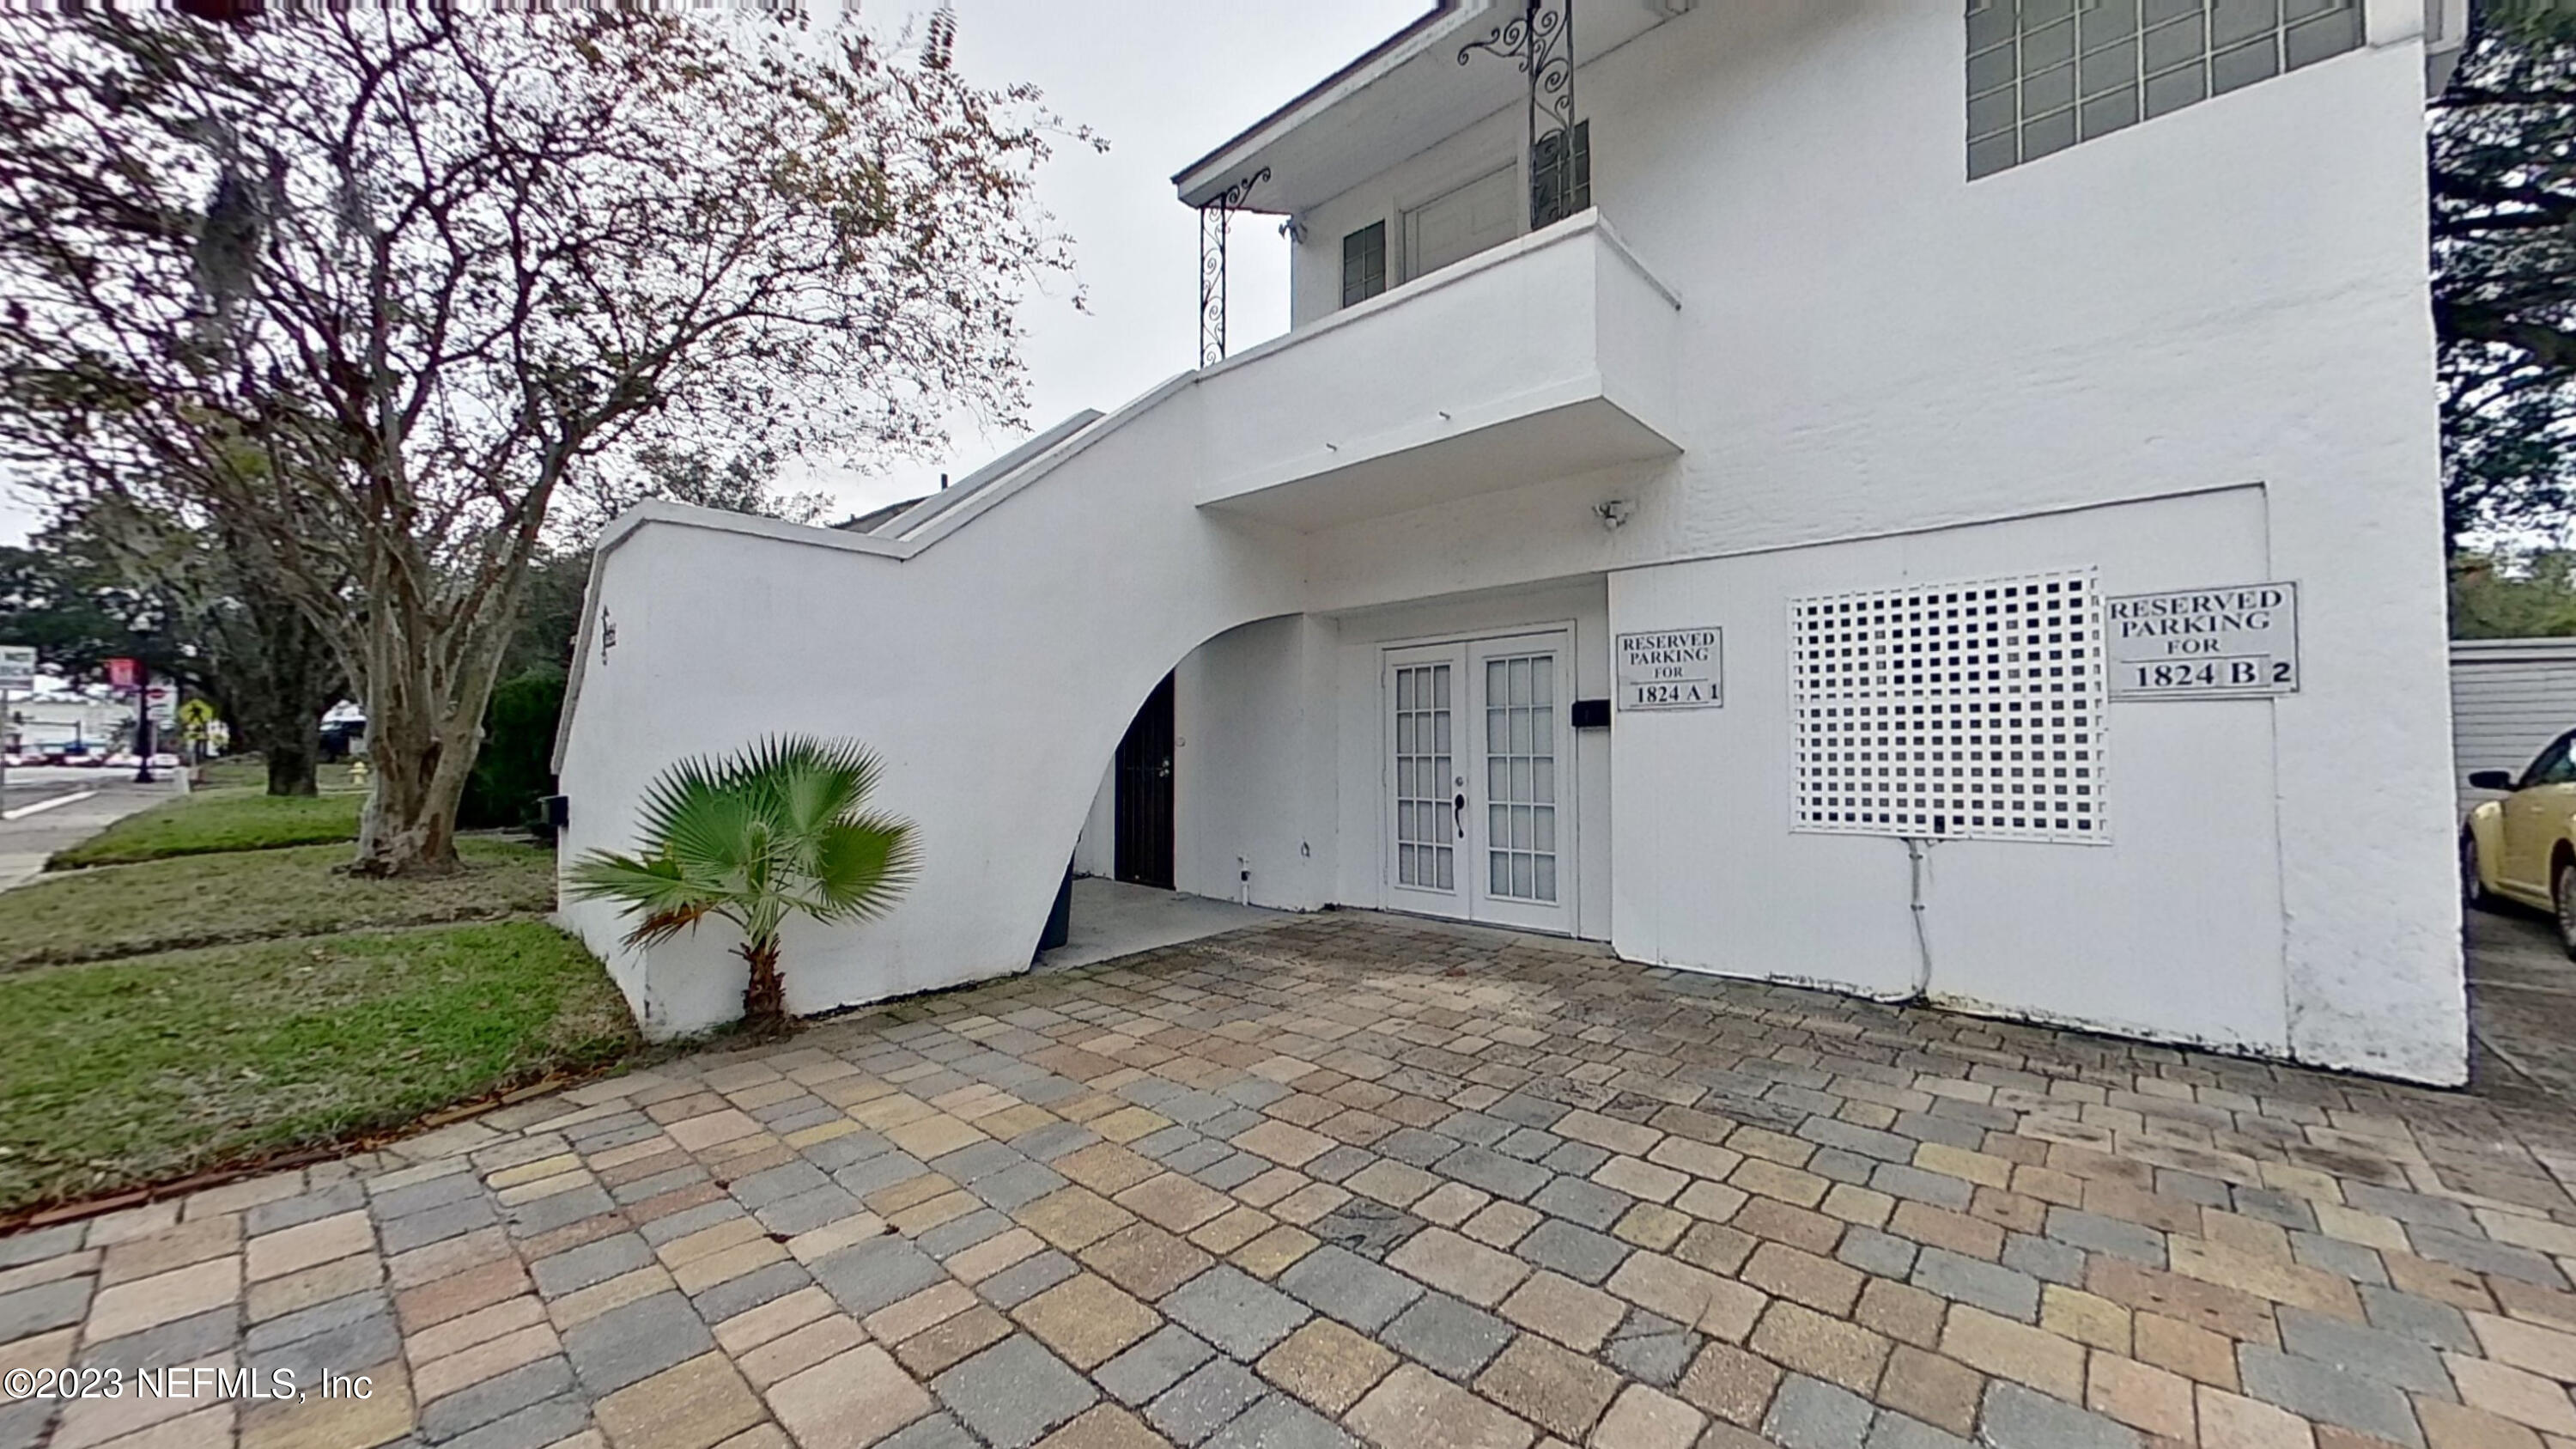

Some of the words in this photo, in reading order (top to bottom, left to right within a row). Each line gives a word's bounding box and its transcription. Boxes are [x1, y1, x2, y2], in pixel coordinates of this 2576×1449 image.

[2111, 590, 2282, 619] RESERVED
[2123, 612, 2270, 637] PARKING
[1623, 631, 1715, 651] RESERVED
[2167, 638, 2221, 654] FOR
[1631, 647, 1709, 666] PARKING
[1655, 667, 1683, 679] FOR
[2138, 663, 2215, 687] 1824
[2232, 661, 2256, 684] B
[2273, 661, 2291, 683] 2
[1637, 685, 1680, 703] 1824
[1686, 685, 1701, 701] A
[1710, 684, 1718, 700] 1
